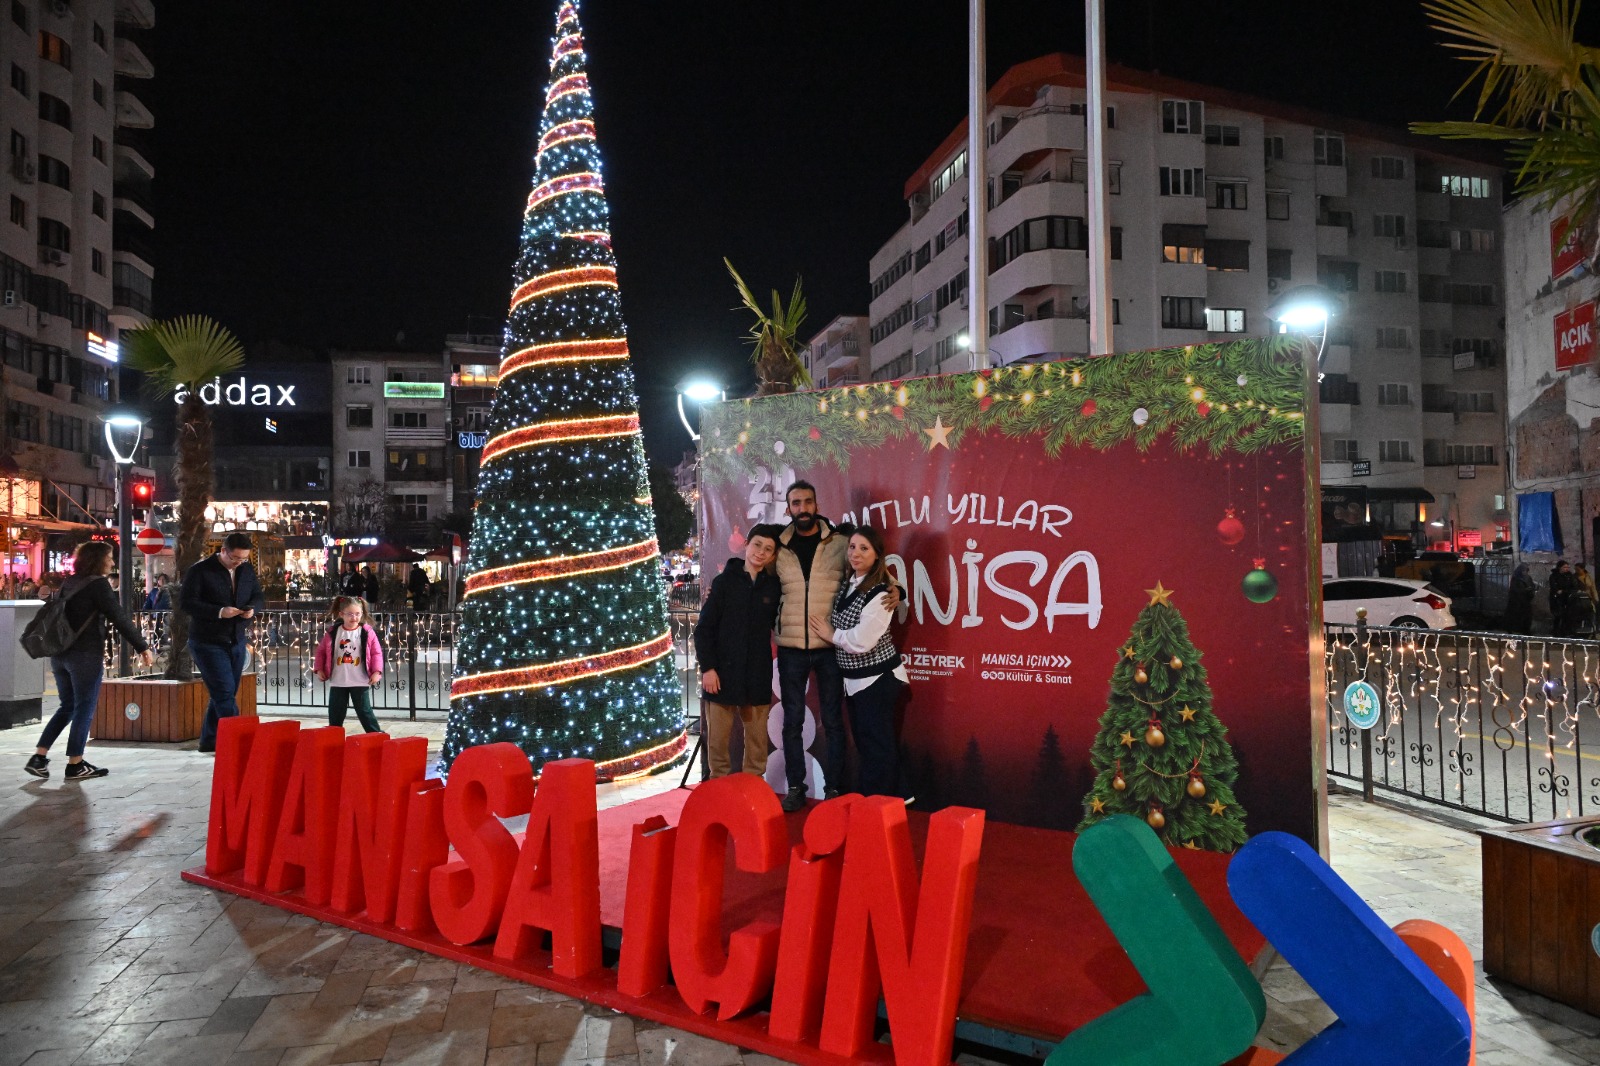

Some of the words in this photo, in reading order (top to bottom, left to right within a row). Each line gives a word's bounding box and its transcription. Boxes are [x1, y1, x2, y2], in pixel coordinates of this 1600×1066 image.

[1560, 322, 1592, 354] AÇIK
[174, 376, 296, 406] addax
[947, 492, 1073, 538] YILLAR
[885, 538, 1103, 634] ANİSA
[914, 653, 966, 669] ZEYREK
[1006, 671, 1033, 683] Kültür
[1035, 673, 1043, 683] &
[1045, 673, 1072, 684] Sanat
